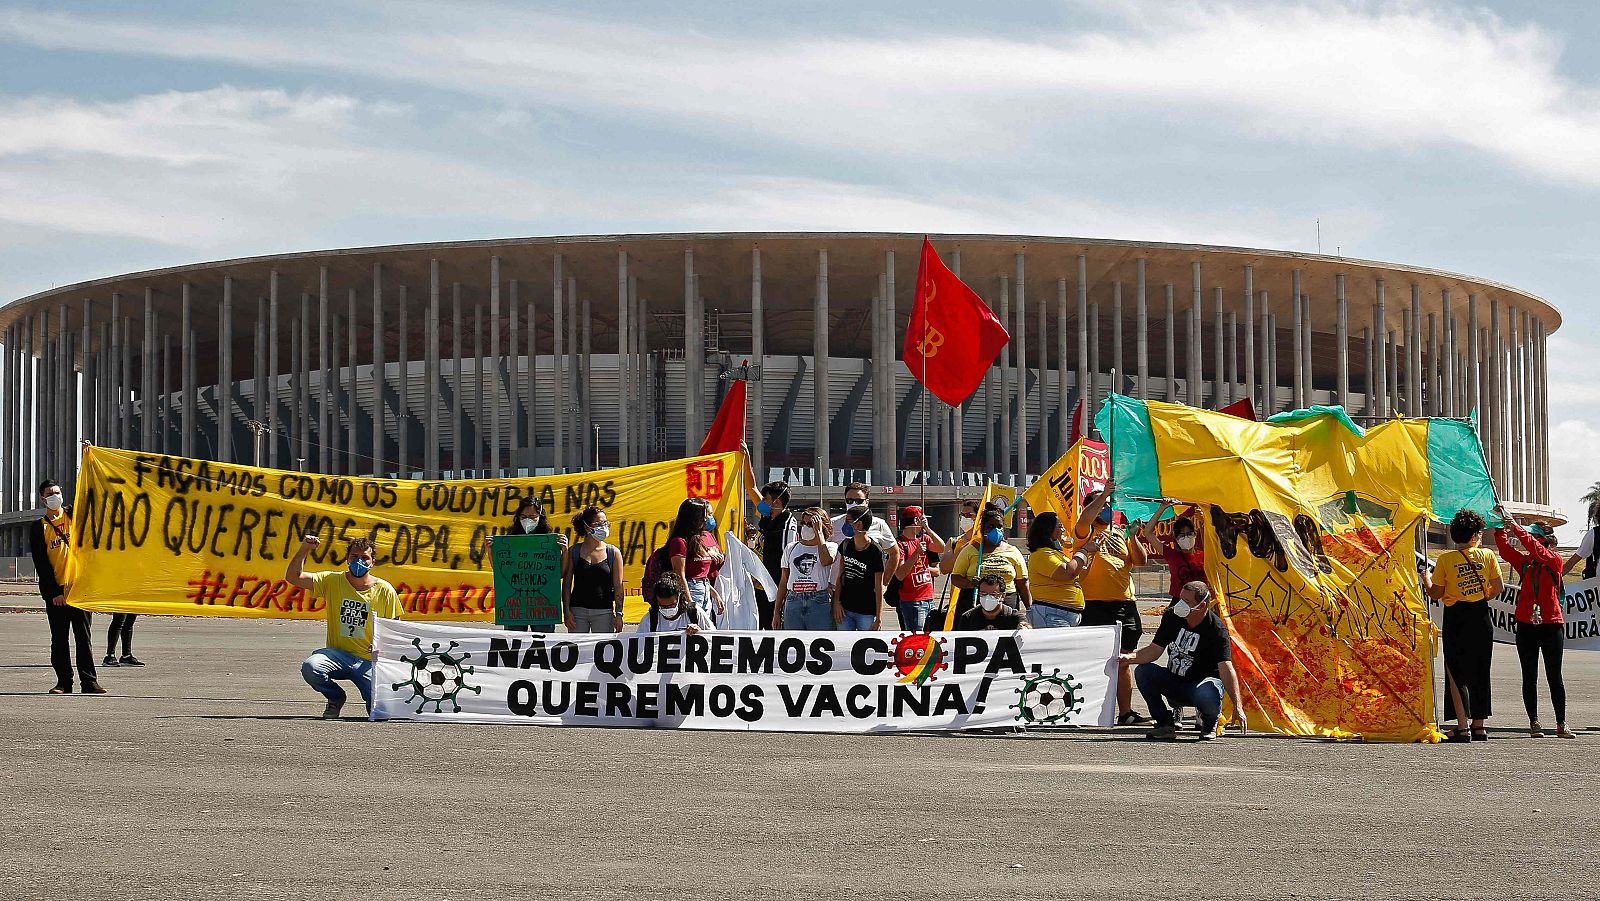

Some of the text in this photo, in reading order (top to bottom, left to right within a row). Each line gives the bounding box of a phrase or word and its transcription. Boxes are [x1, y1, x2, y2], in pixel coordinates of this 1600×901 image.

[133, 456, 268, 498] FAÇAMOS
[279, 474, 353, 506] COMO
[362, 482, 398, 509] OS
[885, 486, 894, 494] 13
[78, 477, 152, 551] NÃO
[517, 560, 543, 571] COVID
[343, 600, 367, 611] COPA
[345, 608, 363, 619] PRA
[341, 616, 366, 627] QUEM
[348, 626, 355, 637] ?
[486, 635, 579, 672] NÃO
[593, 635, 836, 679] QUEREMOS
[506, 677, 993, 721] QUEREMOS VACINA!
